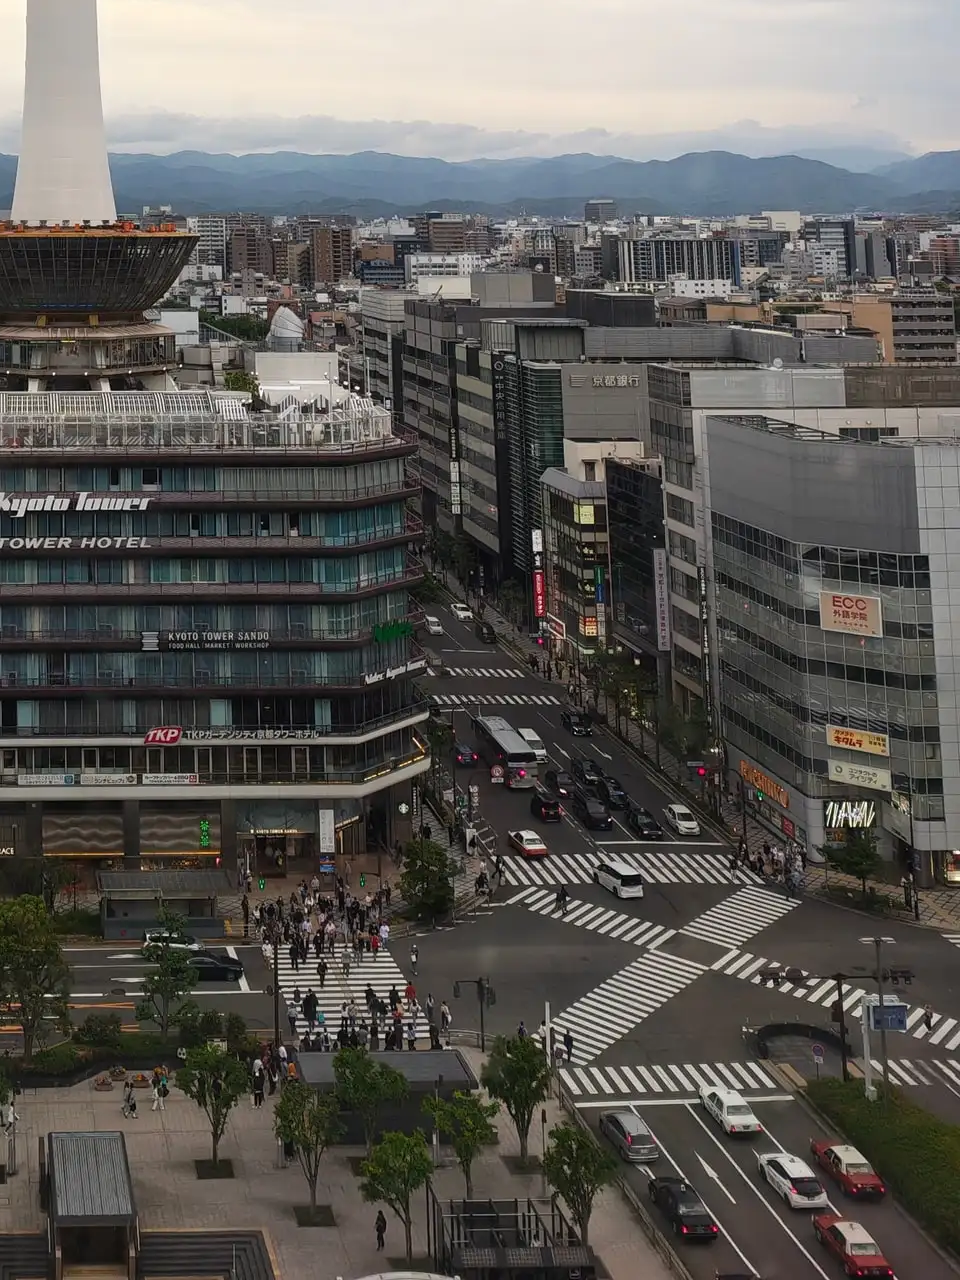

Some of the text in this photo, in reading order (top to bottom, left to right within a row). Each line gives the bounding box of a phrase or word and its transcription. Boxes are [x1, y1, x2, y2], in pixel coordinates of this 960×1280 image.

[592, 375, 640, 387] 京都銀行
[495, 382, 507, 440] 中央信用金庫
[75, 491, 155, 511] Tower
[80, 536, 152, 548] HOTEL
[832, 596, 867, 611] ECC
[833, 609, 868, 621] 外語学院
[168, 631, 269, 641] KYOTO TOWER SANDO
[147, 728, 178, 742] TKP
[834, 735, 864, 748] キタムラ
[848, 767, 878, 778] コンタクトの
[848, 773, 878, 785] アイシティ
